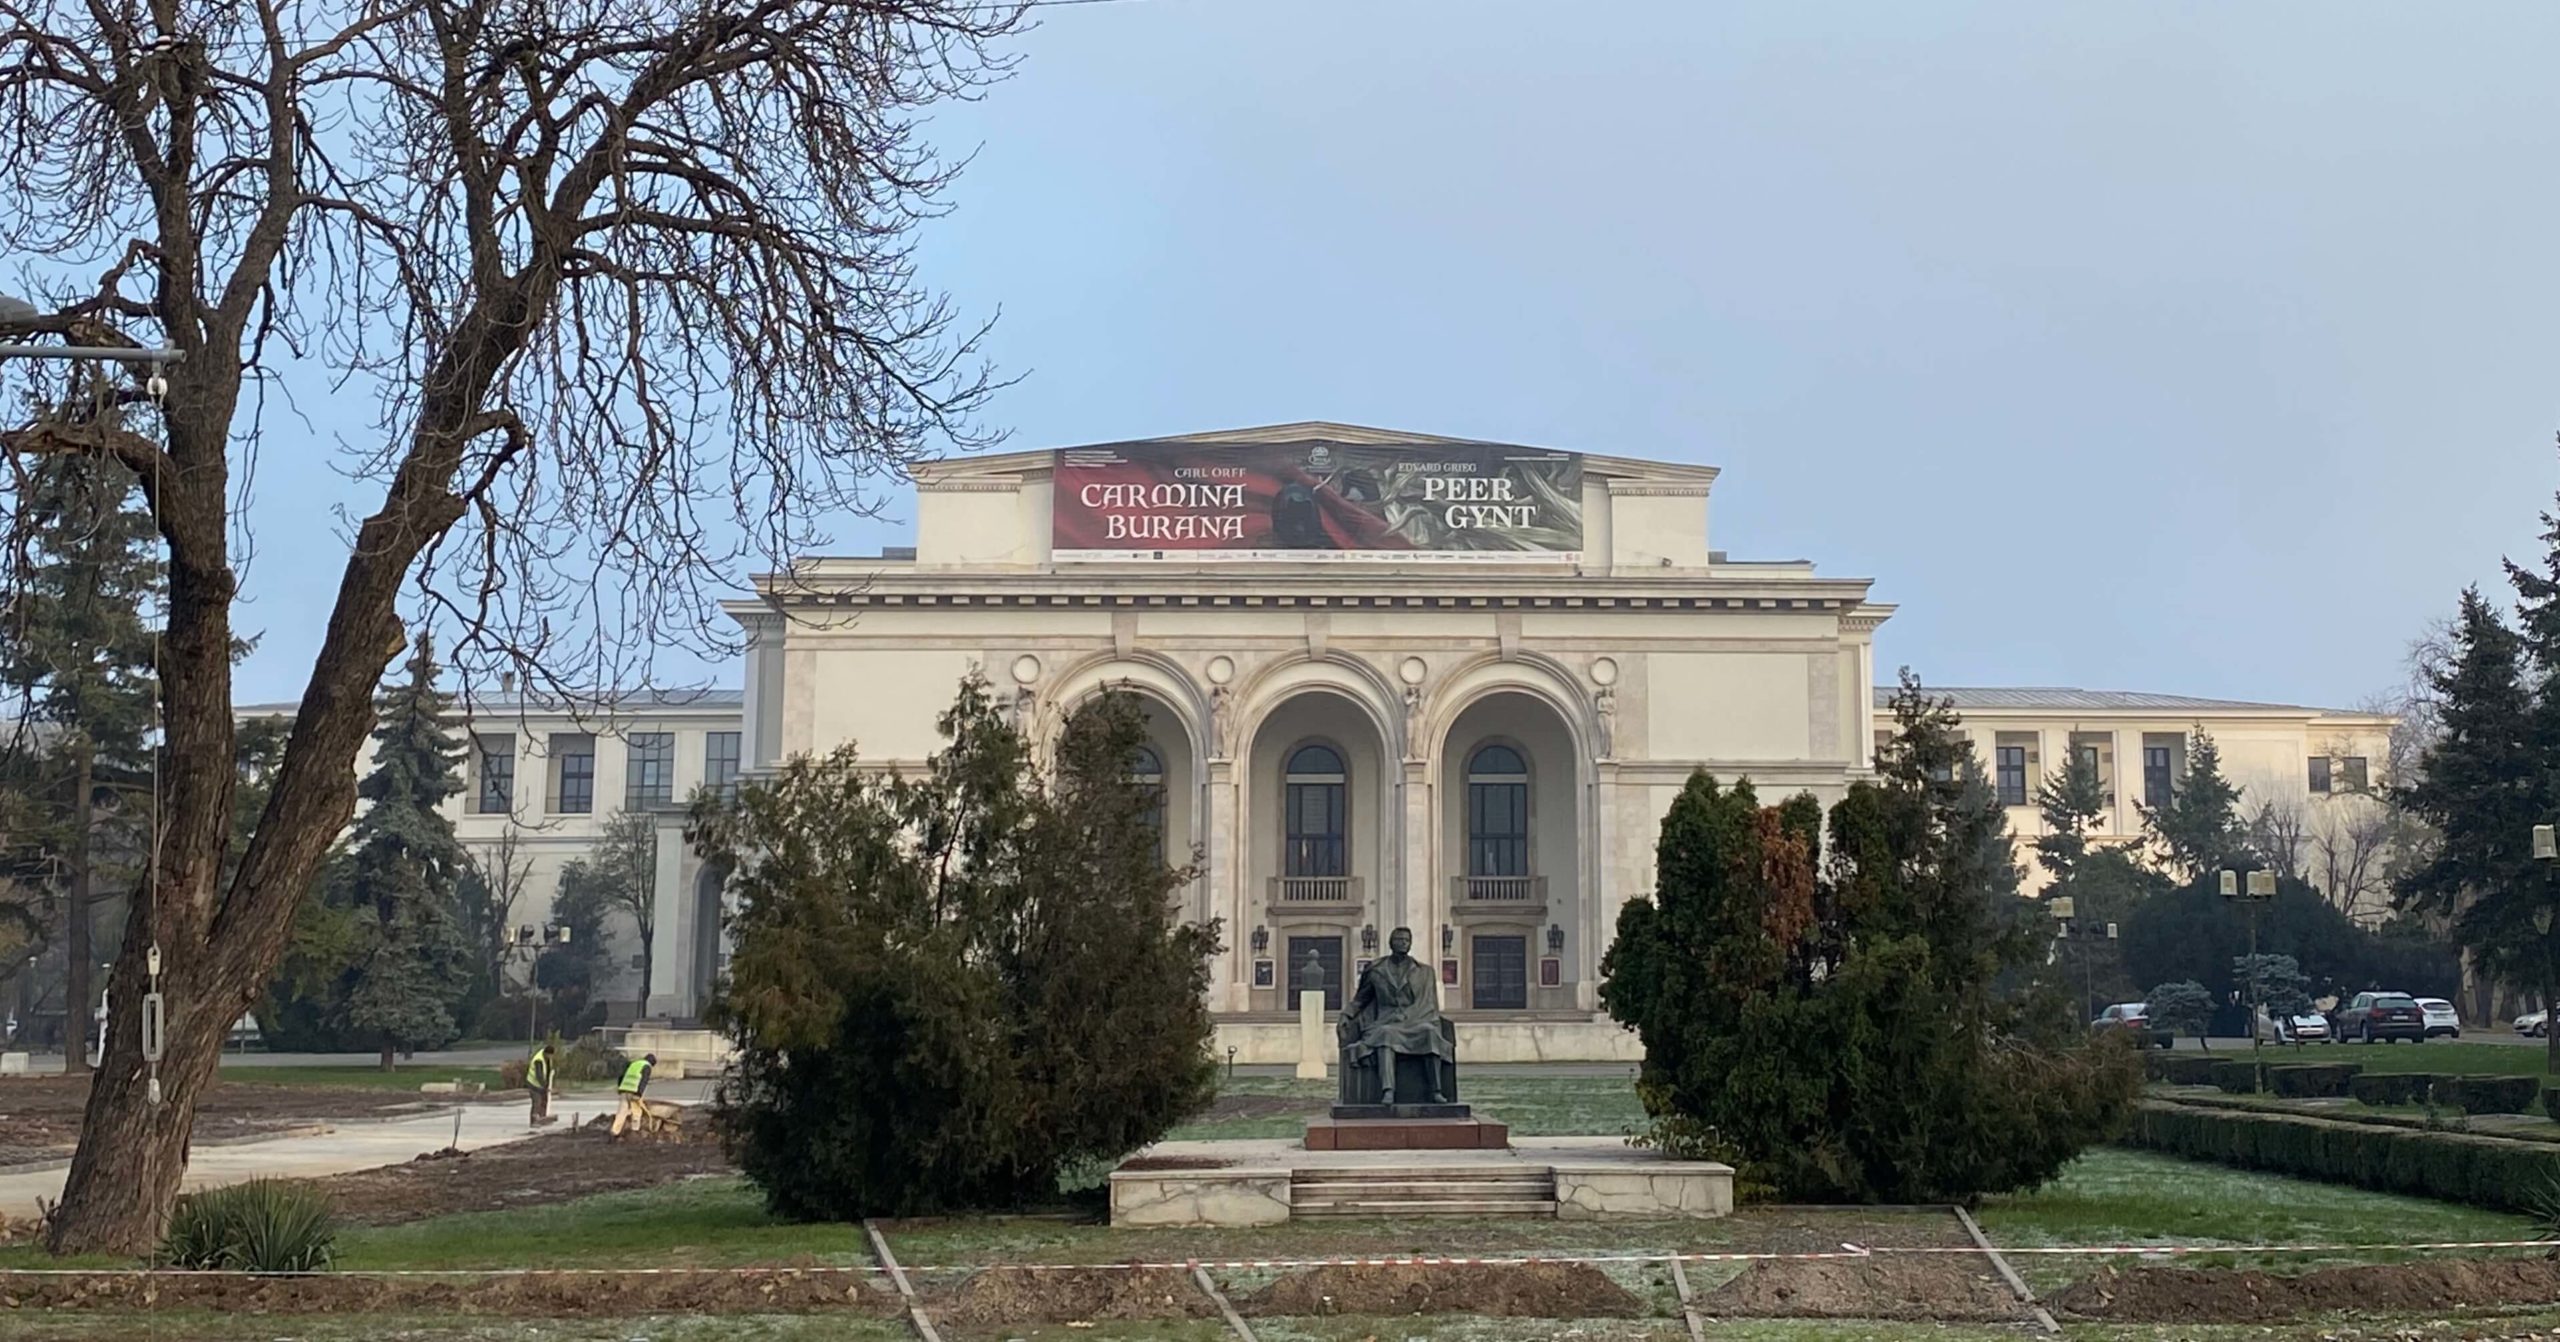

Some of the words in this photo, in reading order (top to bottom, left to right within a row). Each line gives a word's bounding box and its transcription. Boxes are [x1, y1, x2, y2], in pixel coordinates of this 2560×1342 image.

[1174, 467, 1208, 478] CARL
[1211, 467, 1247, 478] ORFF
[1443, 462, 1477, 472] GRIEG
[1081, 483, 1247, 509] CARMINA
[1422, 477, 1514, 502] PEER
[1105, 514, 1247, 541] BURANA
[1445, 505, 1537, 529] GYNT
